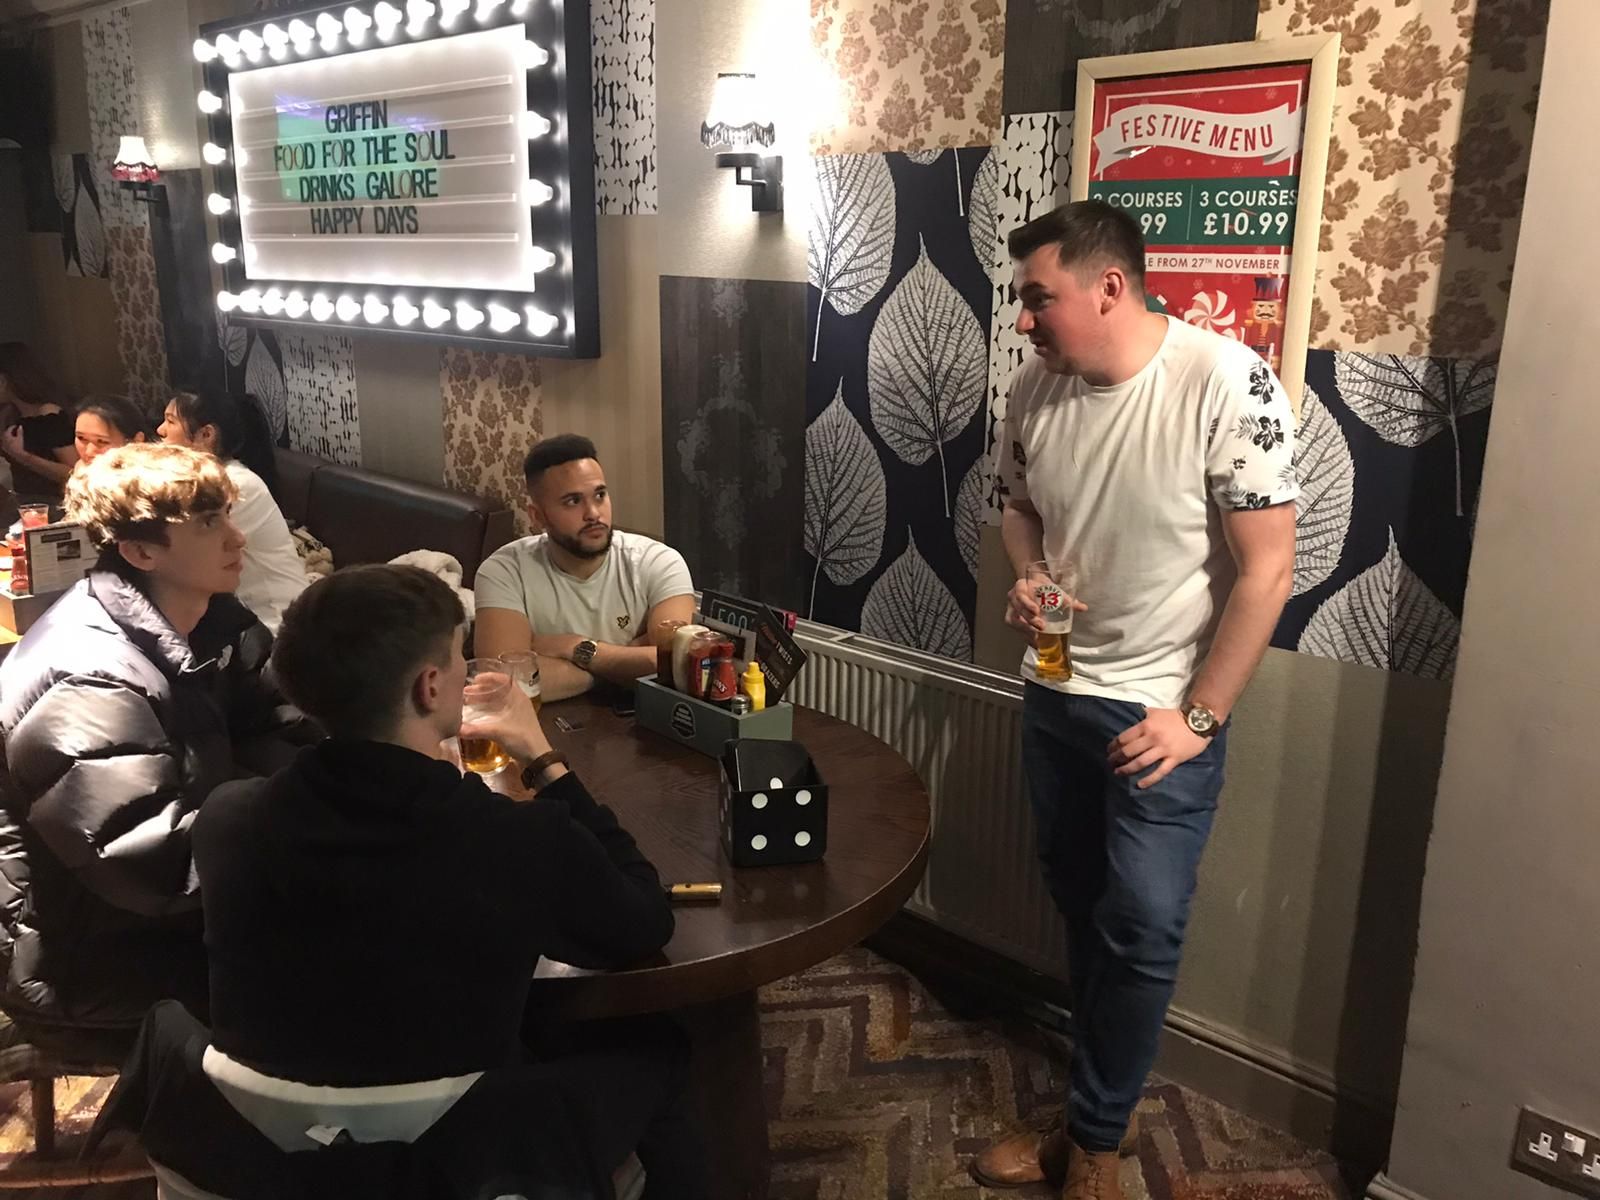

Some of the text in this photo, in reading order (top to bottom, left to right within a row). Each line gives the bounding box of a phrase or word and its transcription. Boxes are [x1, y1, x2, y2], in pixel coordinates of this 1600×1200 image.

[325, 99, 388, 133] GRIFFIN
[1121, 114, 1273, 152] FESTIVE MENU
[274, 129, 456, 171] FOOD FOR THE SOUL
[299, 168, 439, 202] DRINKS GALORE
[1107, 191, 1183, 208] COURSES
[1199, 189, 1298, 207] 3 COURSES
[310, 205, 419, 234] HAPPY DAYS
[1140, 212, 1167, 235] 99
[1203, 212, 1289, 235] £10.99
[1157, 257, 1188, 268] FROM
[1216, 258, 1280, 269] NOVEMBER
[1040, 592, 1060, 606] 13
[718, 608, 757, 630] FOO
